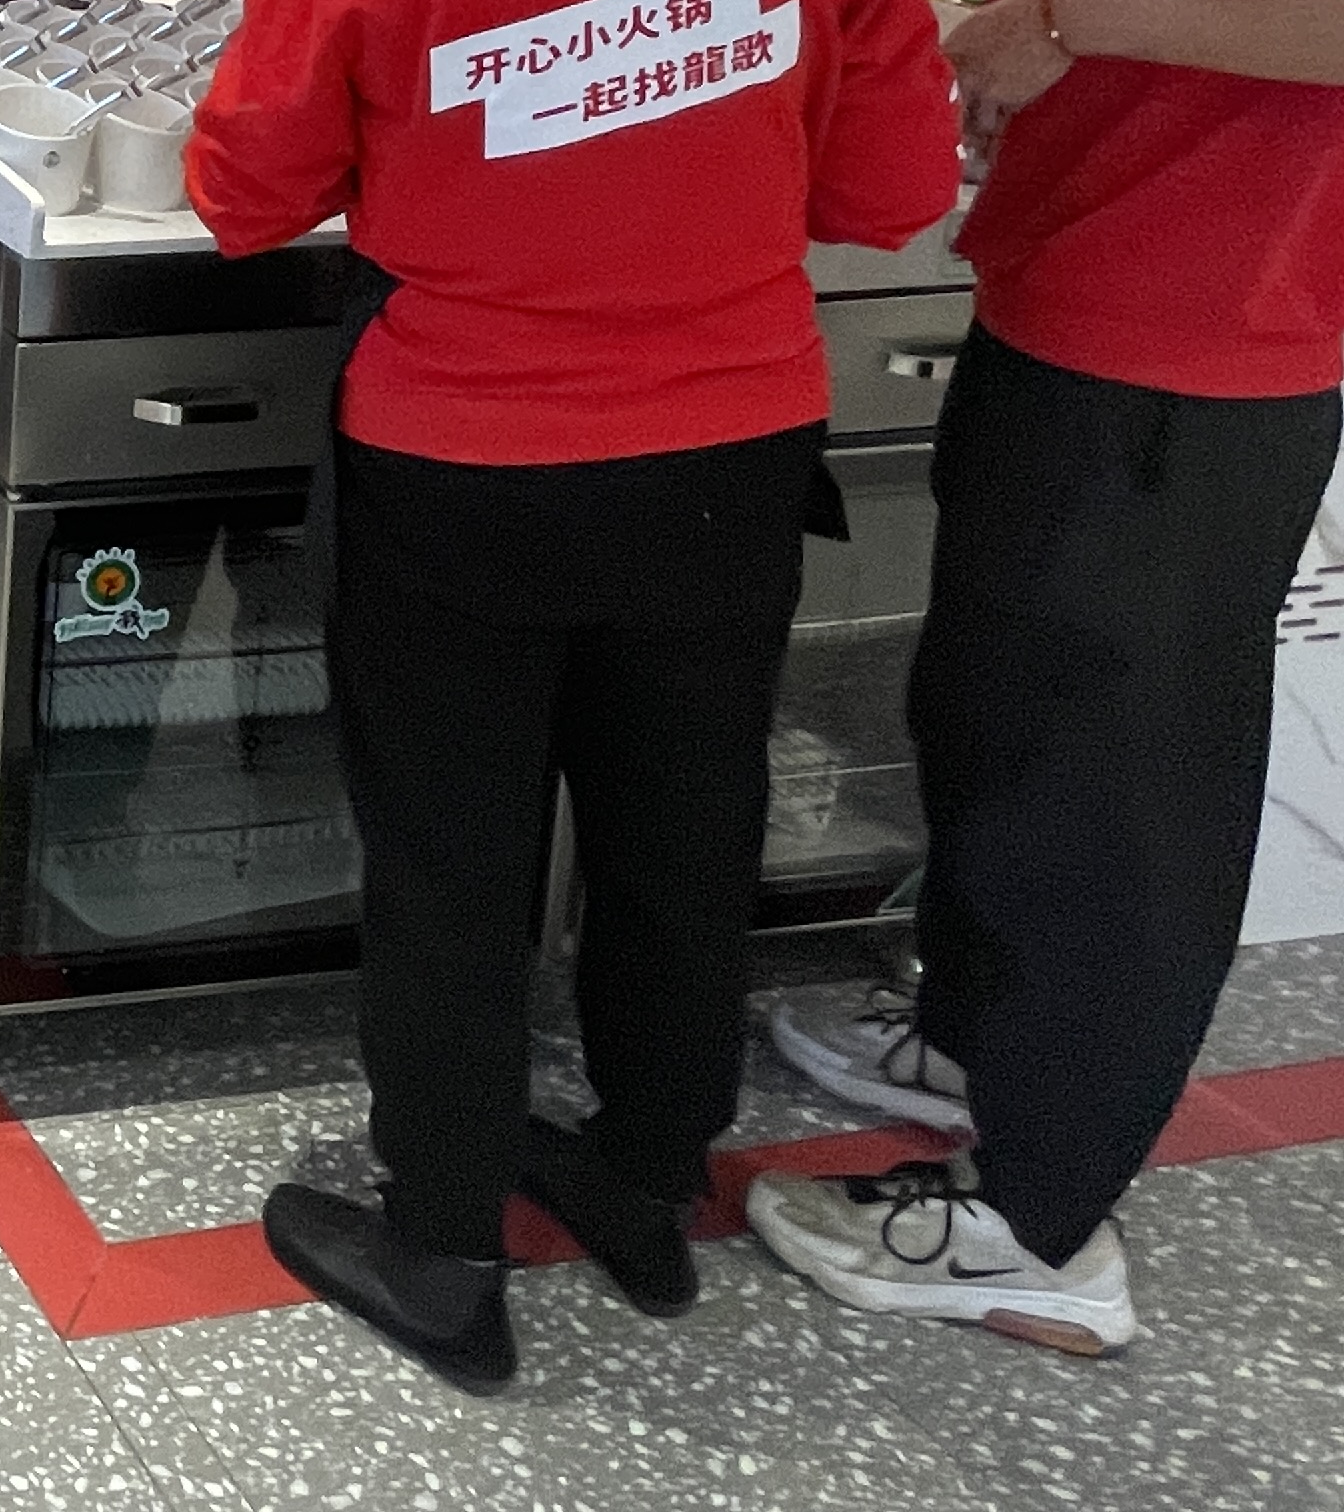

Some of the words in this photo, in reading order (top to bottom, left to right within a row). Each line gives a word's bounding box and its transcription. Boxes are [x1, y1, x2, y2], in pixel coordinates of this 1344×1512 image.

[532, 30, 774, 122] 一起找龍歌
